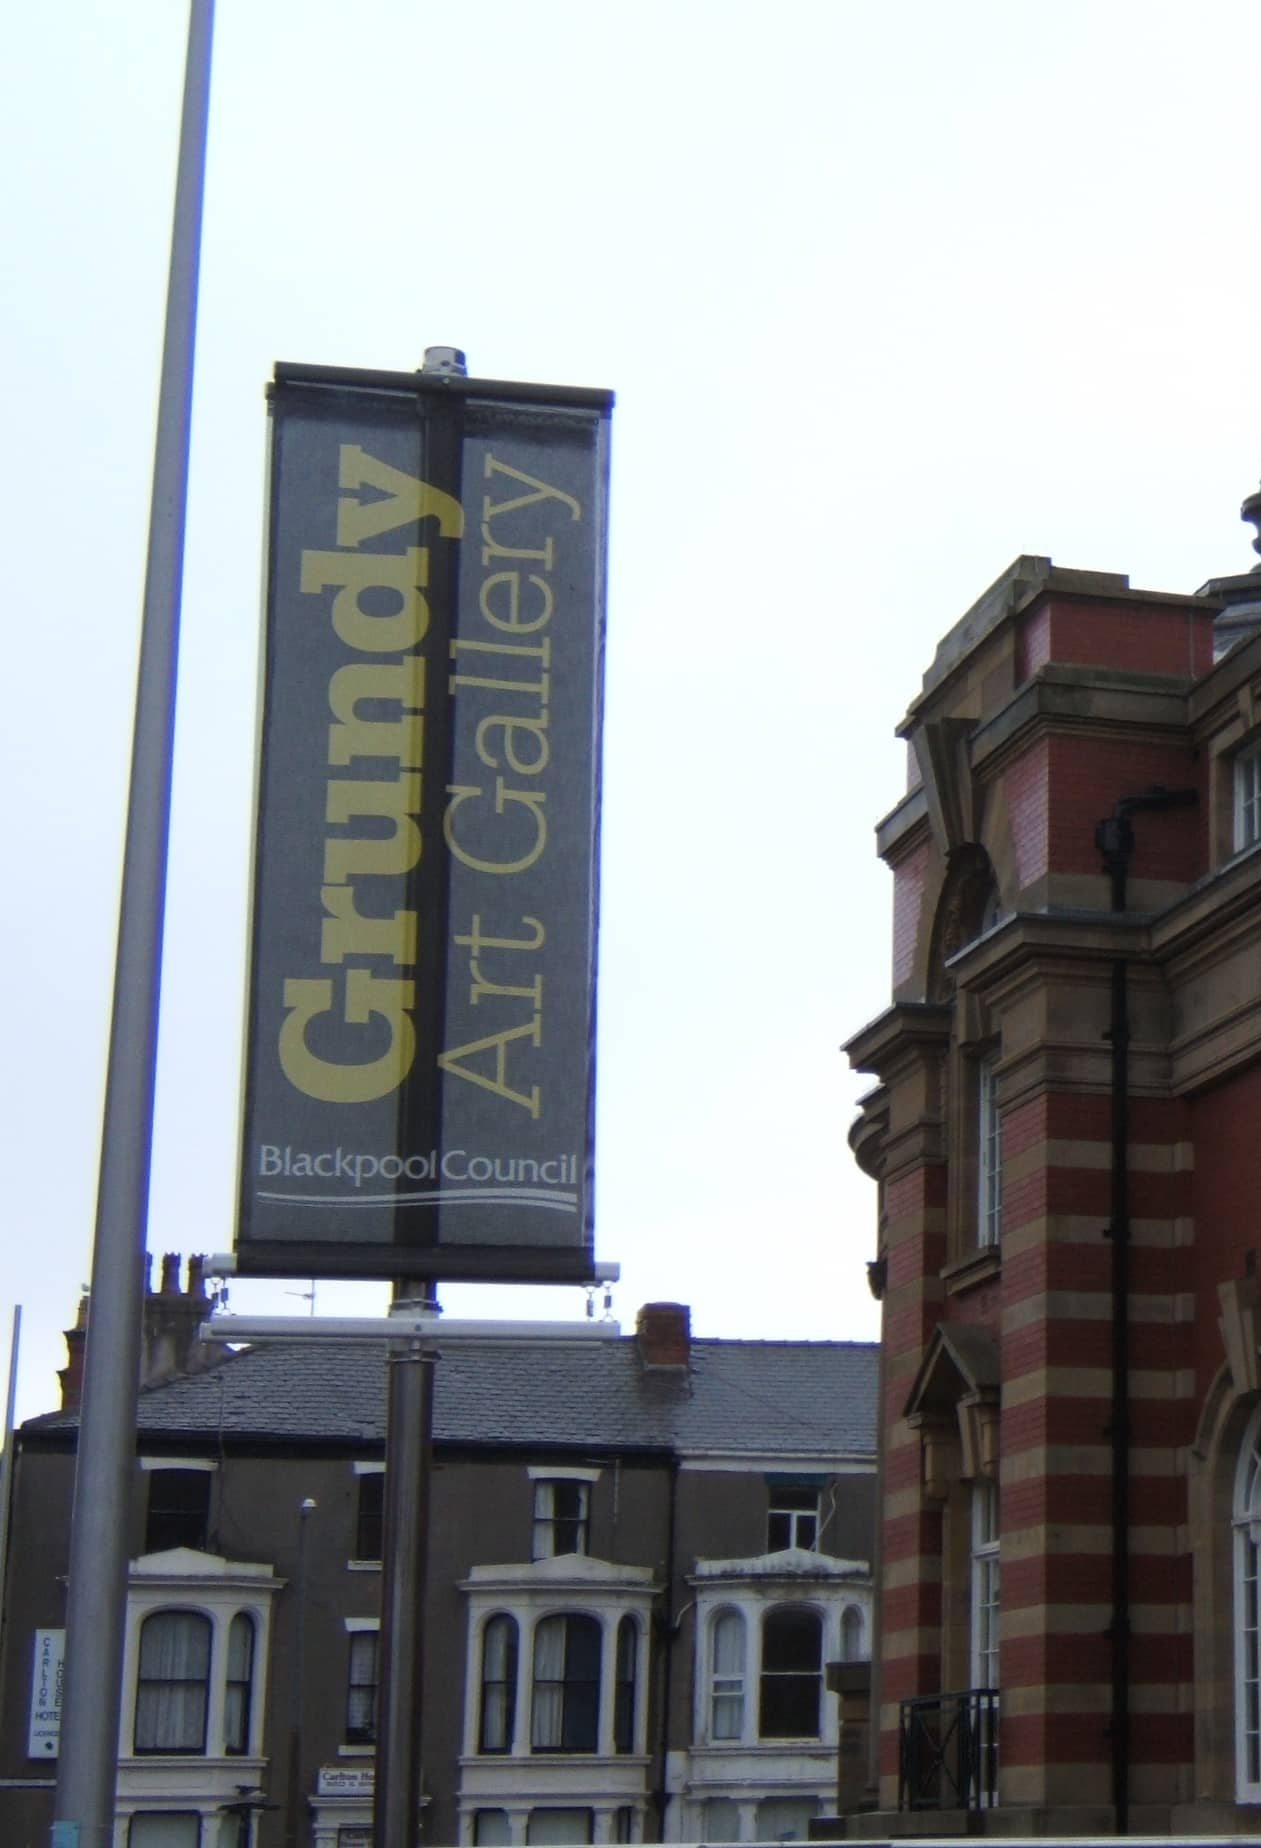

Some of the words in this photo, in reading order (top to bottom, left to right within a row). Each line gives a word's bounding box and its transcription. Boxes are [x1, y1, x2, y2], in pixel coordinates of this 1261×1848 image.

[444, 453, 582, 874] Gallery
[278, 445, 465, 1103] Grundy
[438, 914, 547, 1120] Art
[260, 1144, 437, 1187] Blackpool
[441, 1149, 578, 1185] Council
[38, 1637, 51, 1707] CARLTON
[35, 1711, 60, 1720] HOTE
[361, 1771, 375, 1780] Ho
